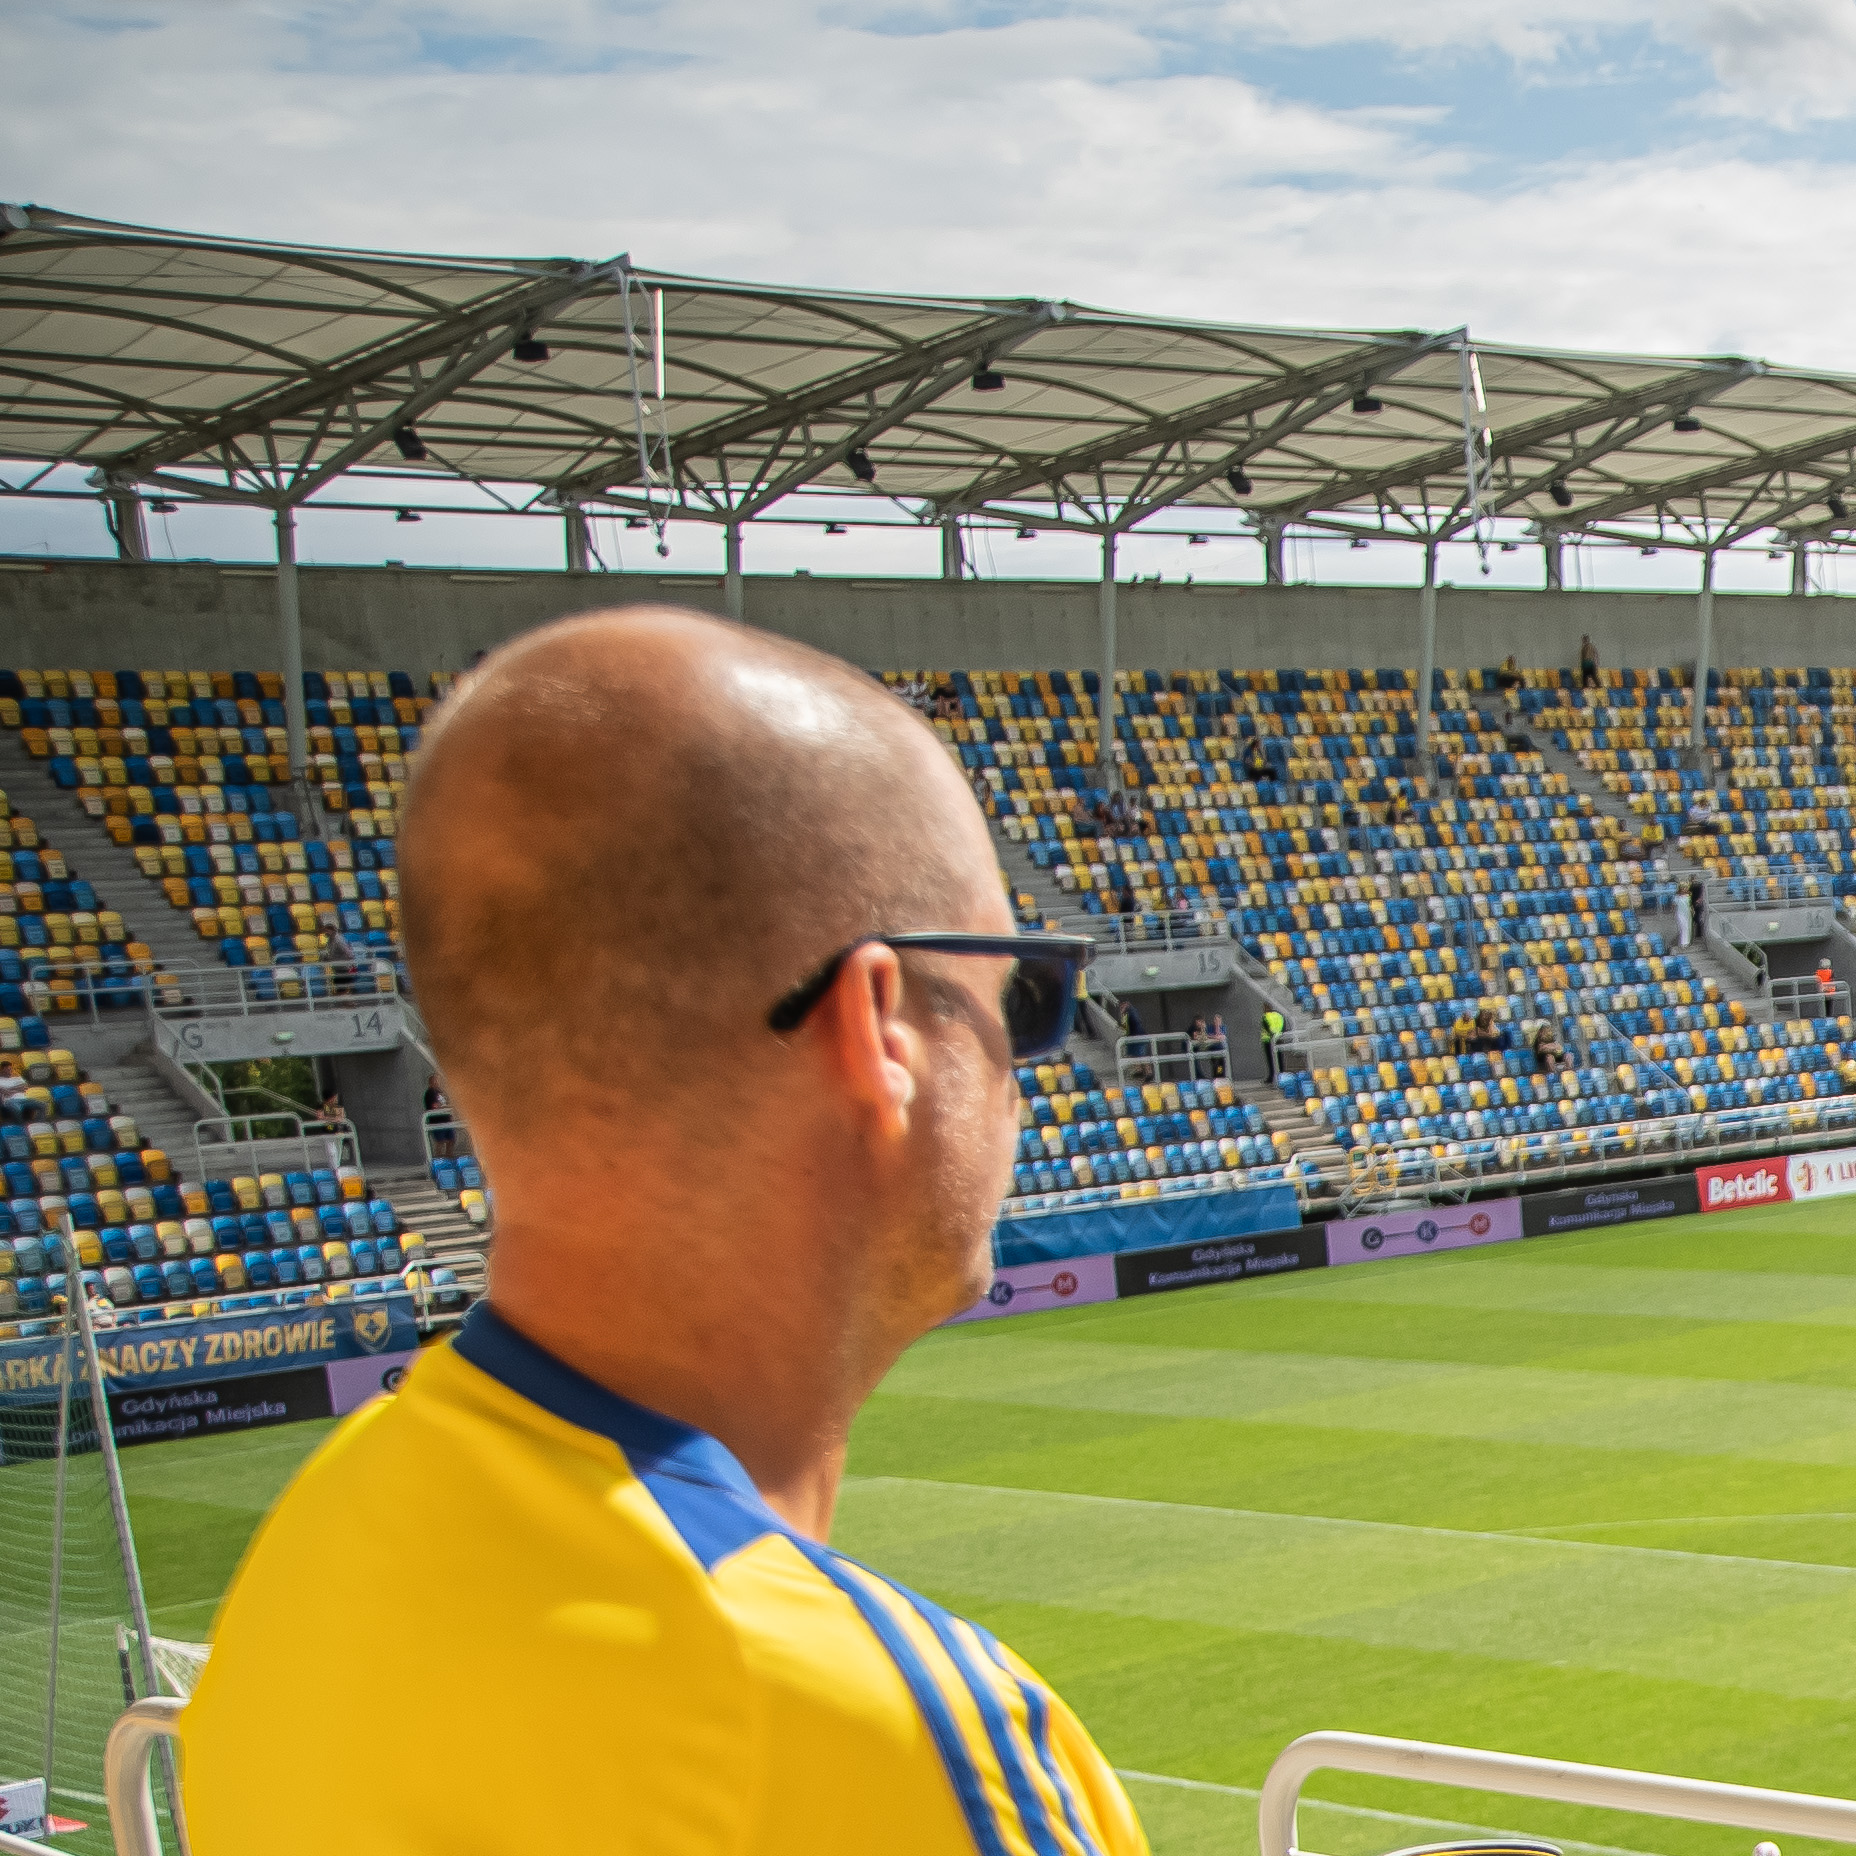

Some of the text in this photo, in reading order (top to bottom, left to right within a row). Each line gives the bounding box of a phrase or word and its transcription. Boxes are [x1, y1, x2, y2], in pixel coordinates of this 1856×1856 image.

[181, 1022, 202, 1050] G
[352, 1010, 384, 1038] 14
[1707, 1168, 1780, 1206] Betclic
[0, 1353, 73, 1391] RKA
[204, 1318, 336, 1365] ZDROWIE
[205, 1401, 287, 1425] Miejska
